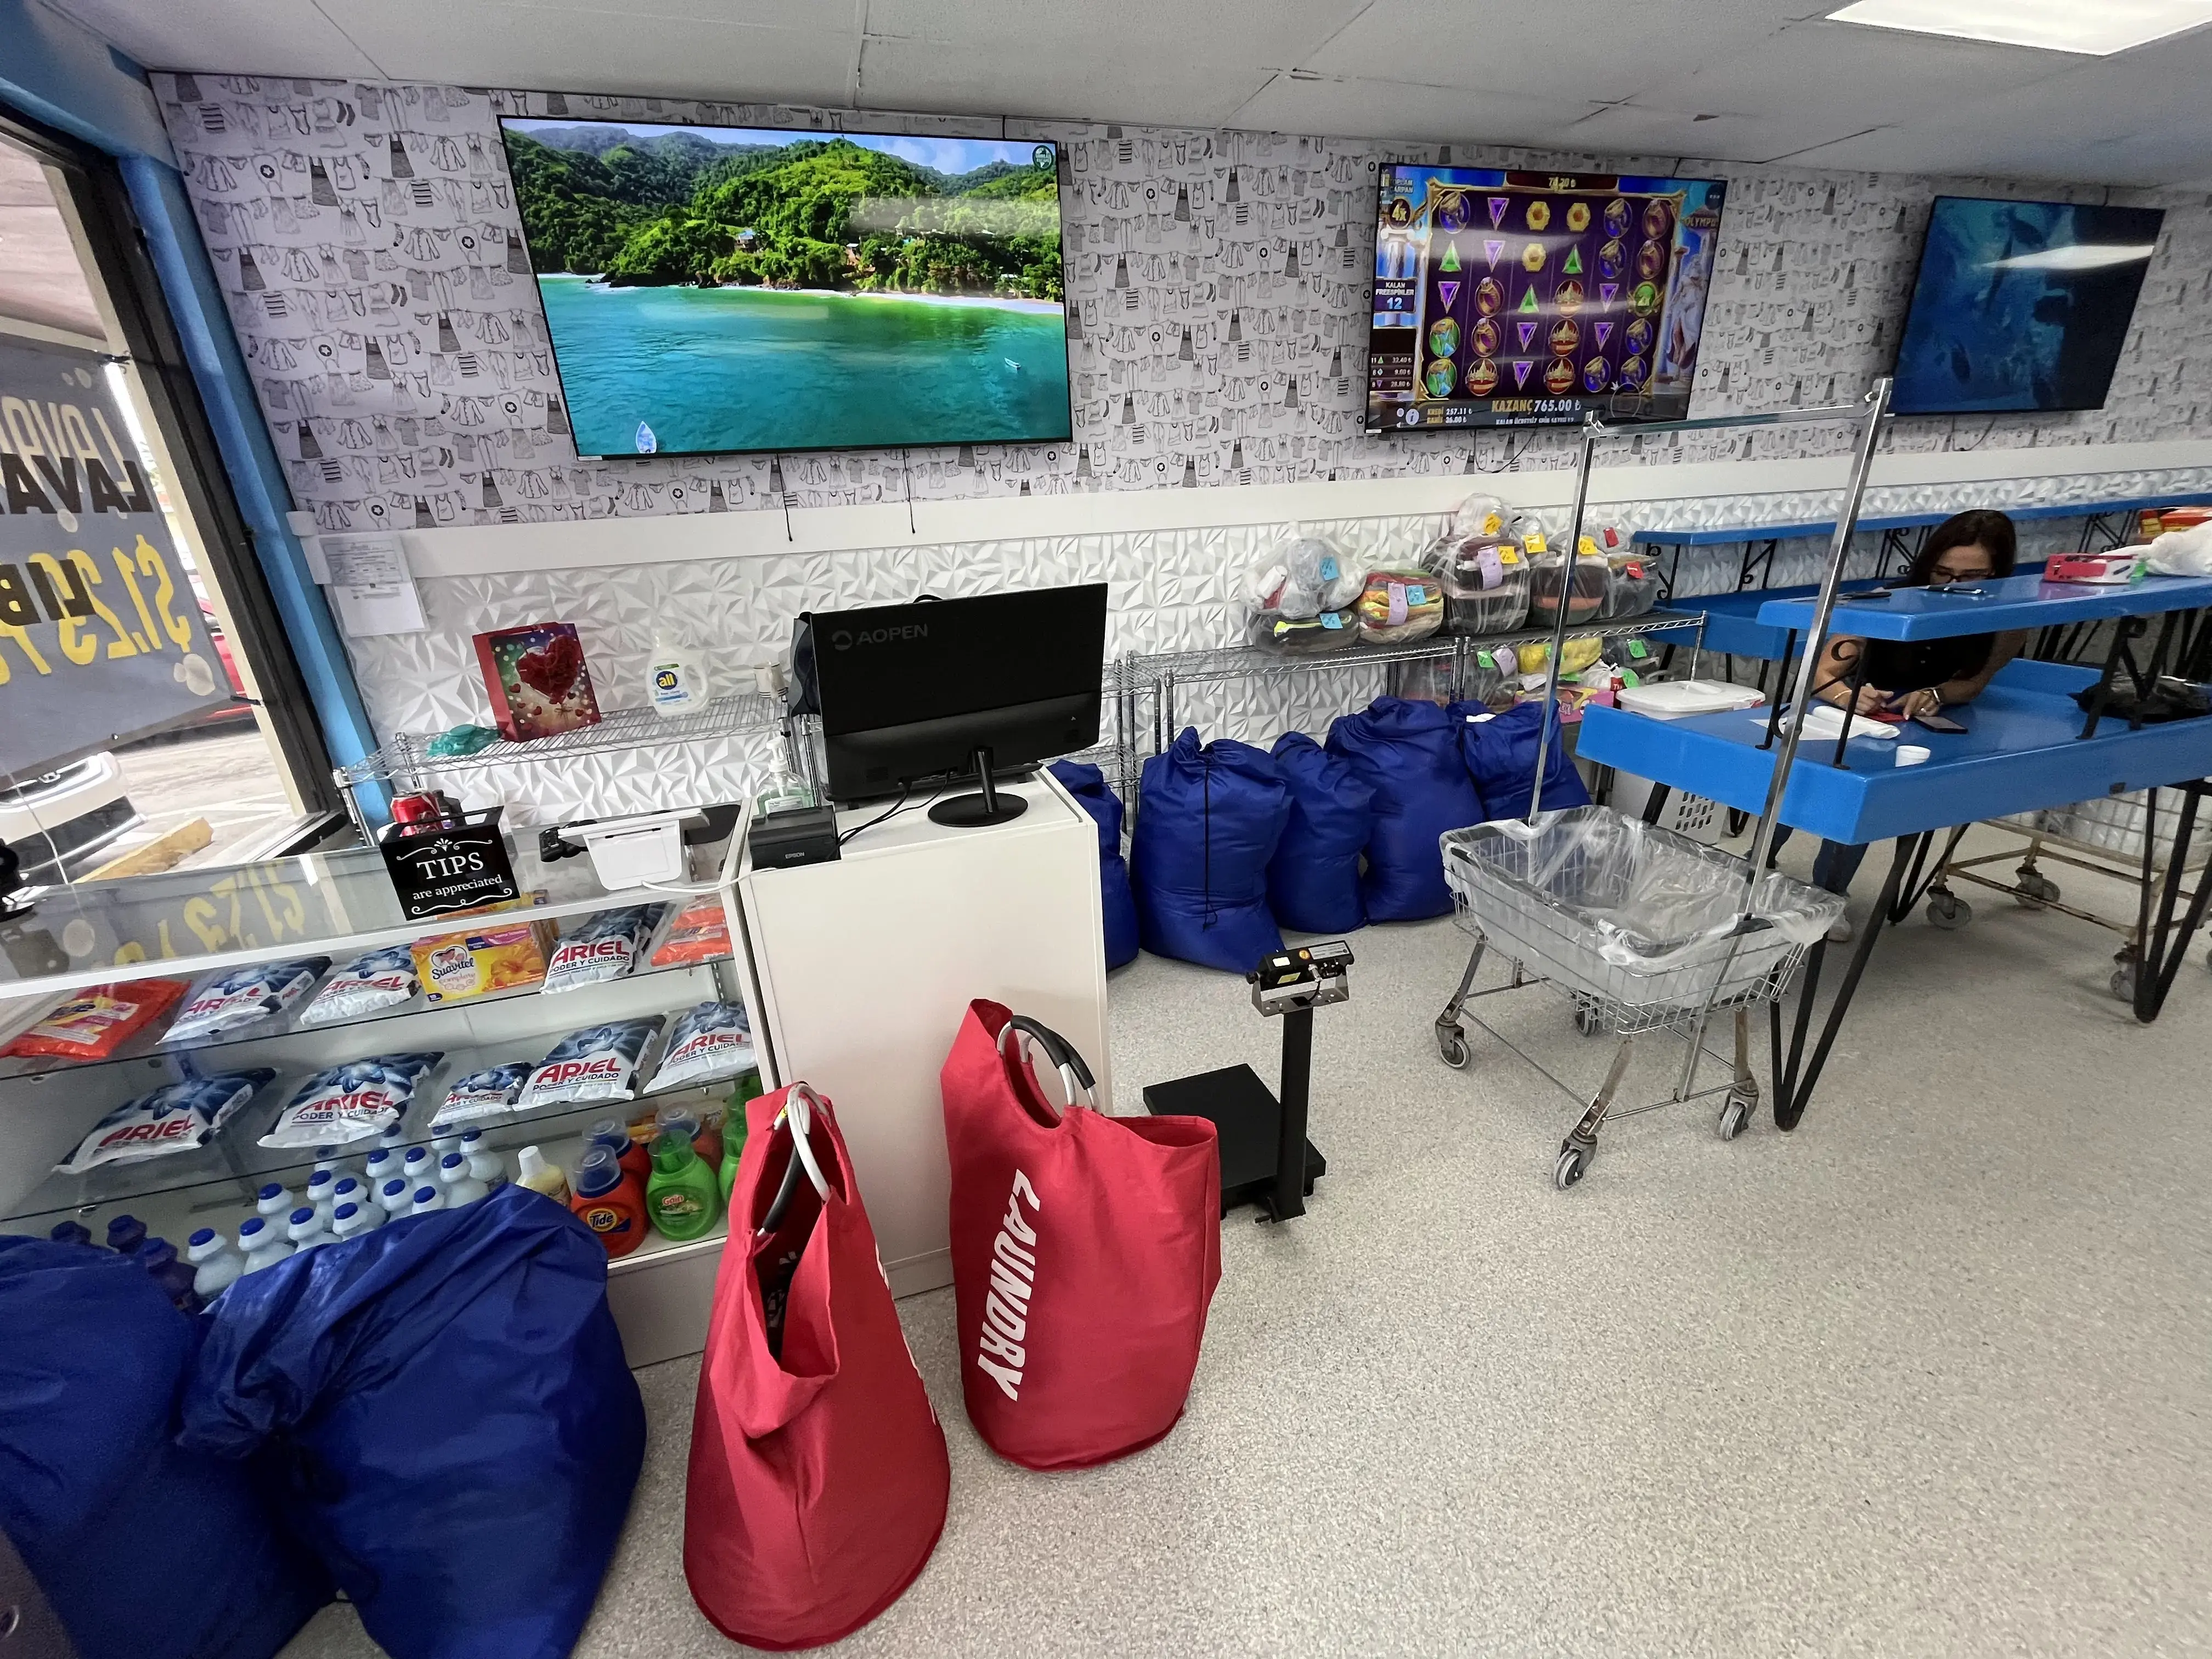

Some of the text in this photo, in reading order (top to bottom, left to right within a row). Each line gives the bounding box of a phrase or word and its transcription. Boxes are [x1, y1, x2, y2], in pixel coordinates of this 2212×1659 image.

[1387, 297, 1402, 309] 12
[1492, 399, 1533, 414] KAZANÇ
[1534, 399, 1572, 413] 765.00
[856, 623, 929, 646] AOPEN
[659, 673, 675, 687] all
[416, 852, 484, 879] TIPS
[412, 874, 503, 900] are appreciated
[549, 962, 577, 973] PODER
[588, 956, 630, 964] CUIDADO
[552, 941, 630, 968] ARIEL
[431, 957, 474, 980] Suavitel
[670, 1034, 751, 1063] ARIEL
[535, 1058, 622, 1084] ARIEL
[575, 1073, 619, 1082] CUIDADO
[292, 1111, 334, 1121] PODER
[99, 1114, 196, 1147] ARIEL
[662, 1194, 685, 1206] Gain
[589, 1213, 614, 1228] Tide
[977, 1167, 1041, 1403] LAUNDRY
